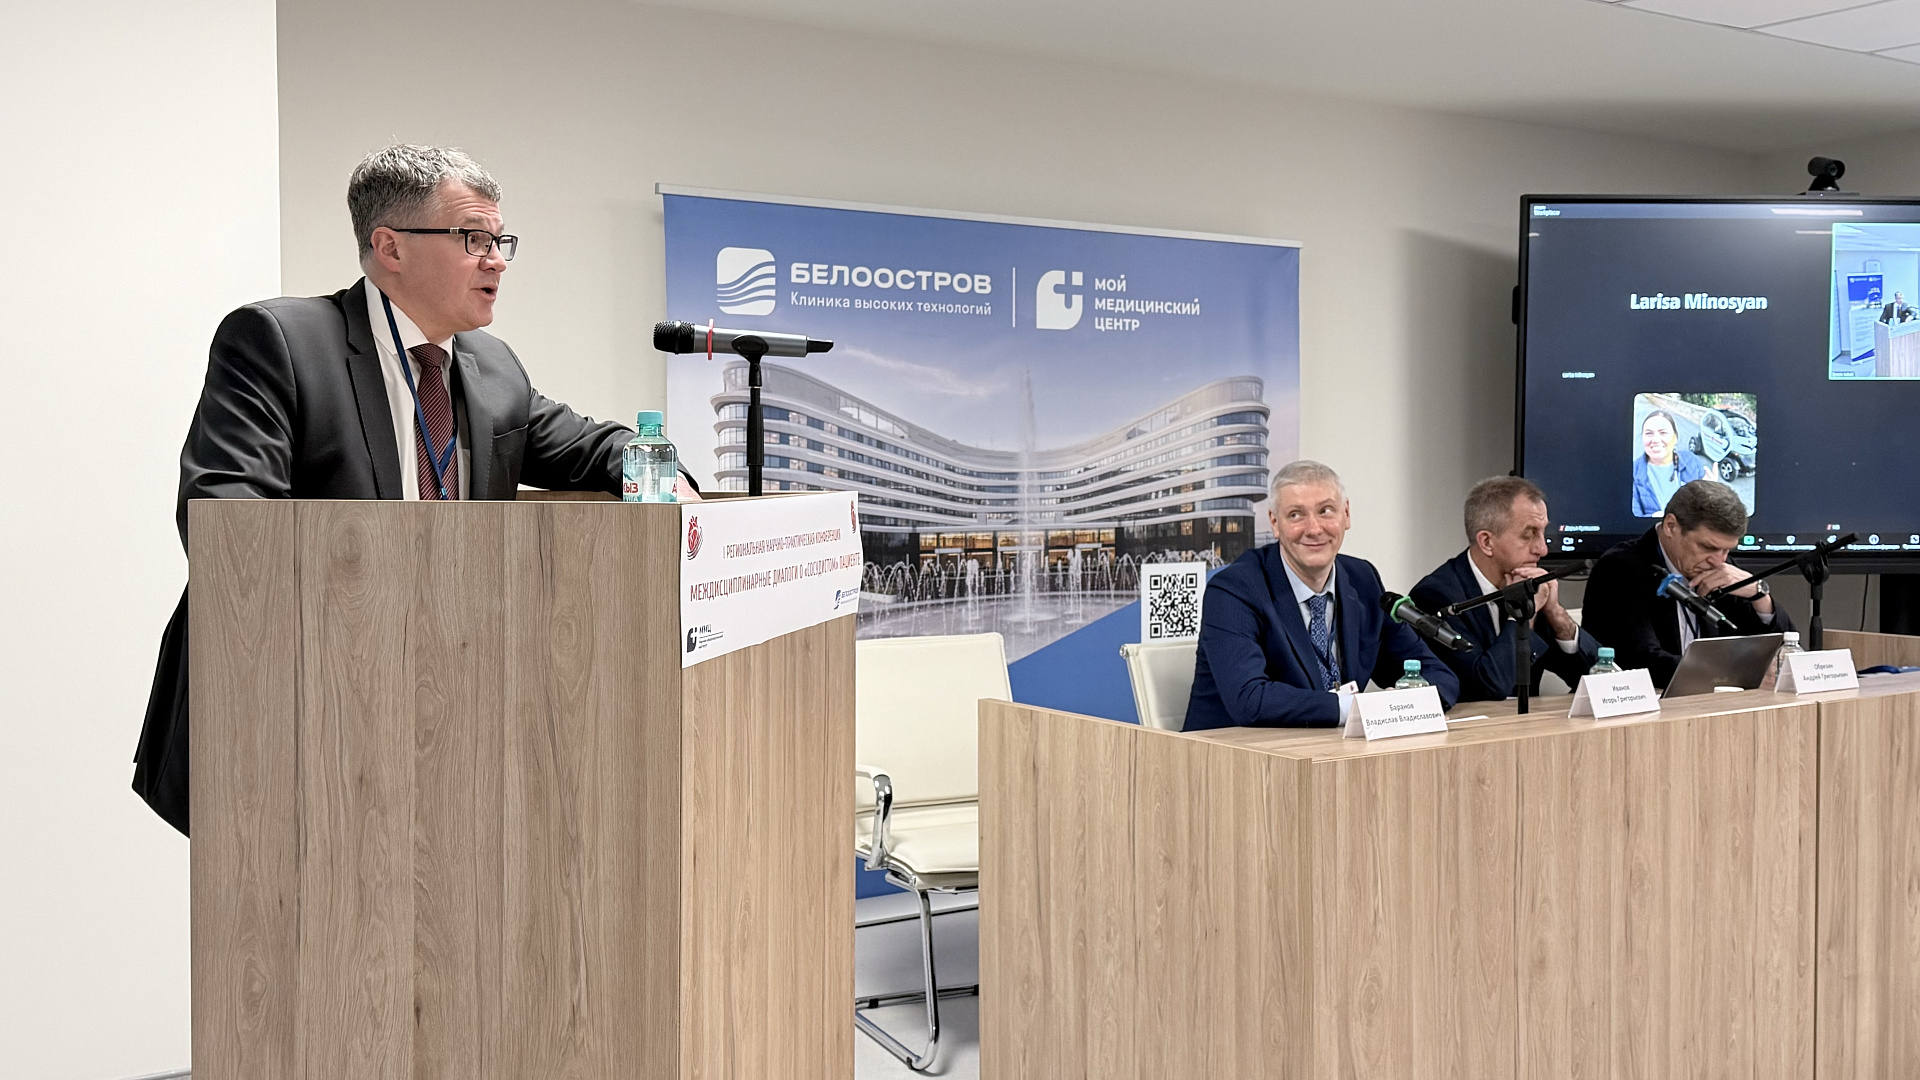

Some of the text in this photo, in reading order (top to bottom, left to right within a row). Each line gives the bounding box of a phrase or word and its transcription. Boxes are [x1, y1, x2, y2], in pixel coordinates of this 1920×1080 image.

[790, 262, 992, 295] БЕЛООСТРОВ
[1094, 274, 1127, 292] МОЙ
[790, 291, 992, 316] Клиника высоких технологий
[1094, 297, 1200, 315] МЕДИЦИНСКИЙ
[1630, 292, 1768, 314] Larisa Minosyan
[1094, 317, 1140, 332] ЦЕНТР
[726, 540, 765, 559] РЕГИОНАЛЬНАЯ
[766, 532, 815, 552] НАУЧНО-ПРАКТИЧЕСКАЯ
[690, 570, 772, 602] МЕЖДИСЦИПЛИНАРНЫЕ
[772, 565, 799, 588] ДИАЛОГИ
[799, 564, 804, 579] О
[839, 552, 861, 571] ПАЦИЕНТЕ
[1389, 703, 1415, 712] Баранов
[1601, 694, 1647, 705] Игорь Григорьевич
[1366, 711, 1442, 727] Владислав Владиславович
